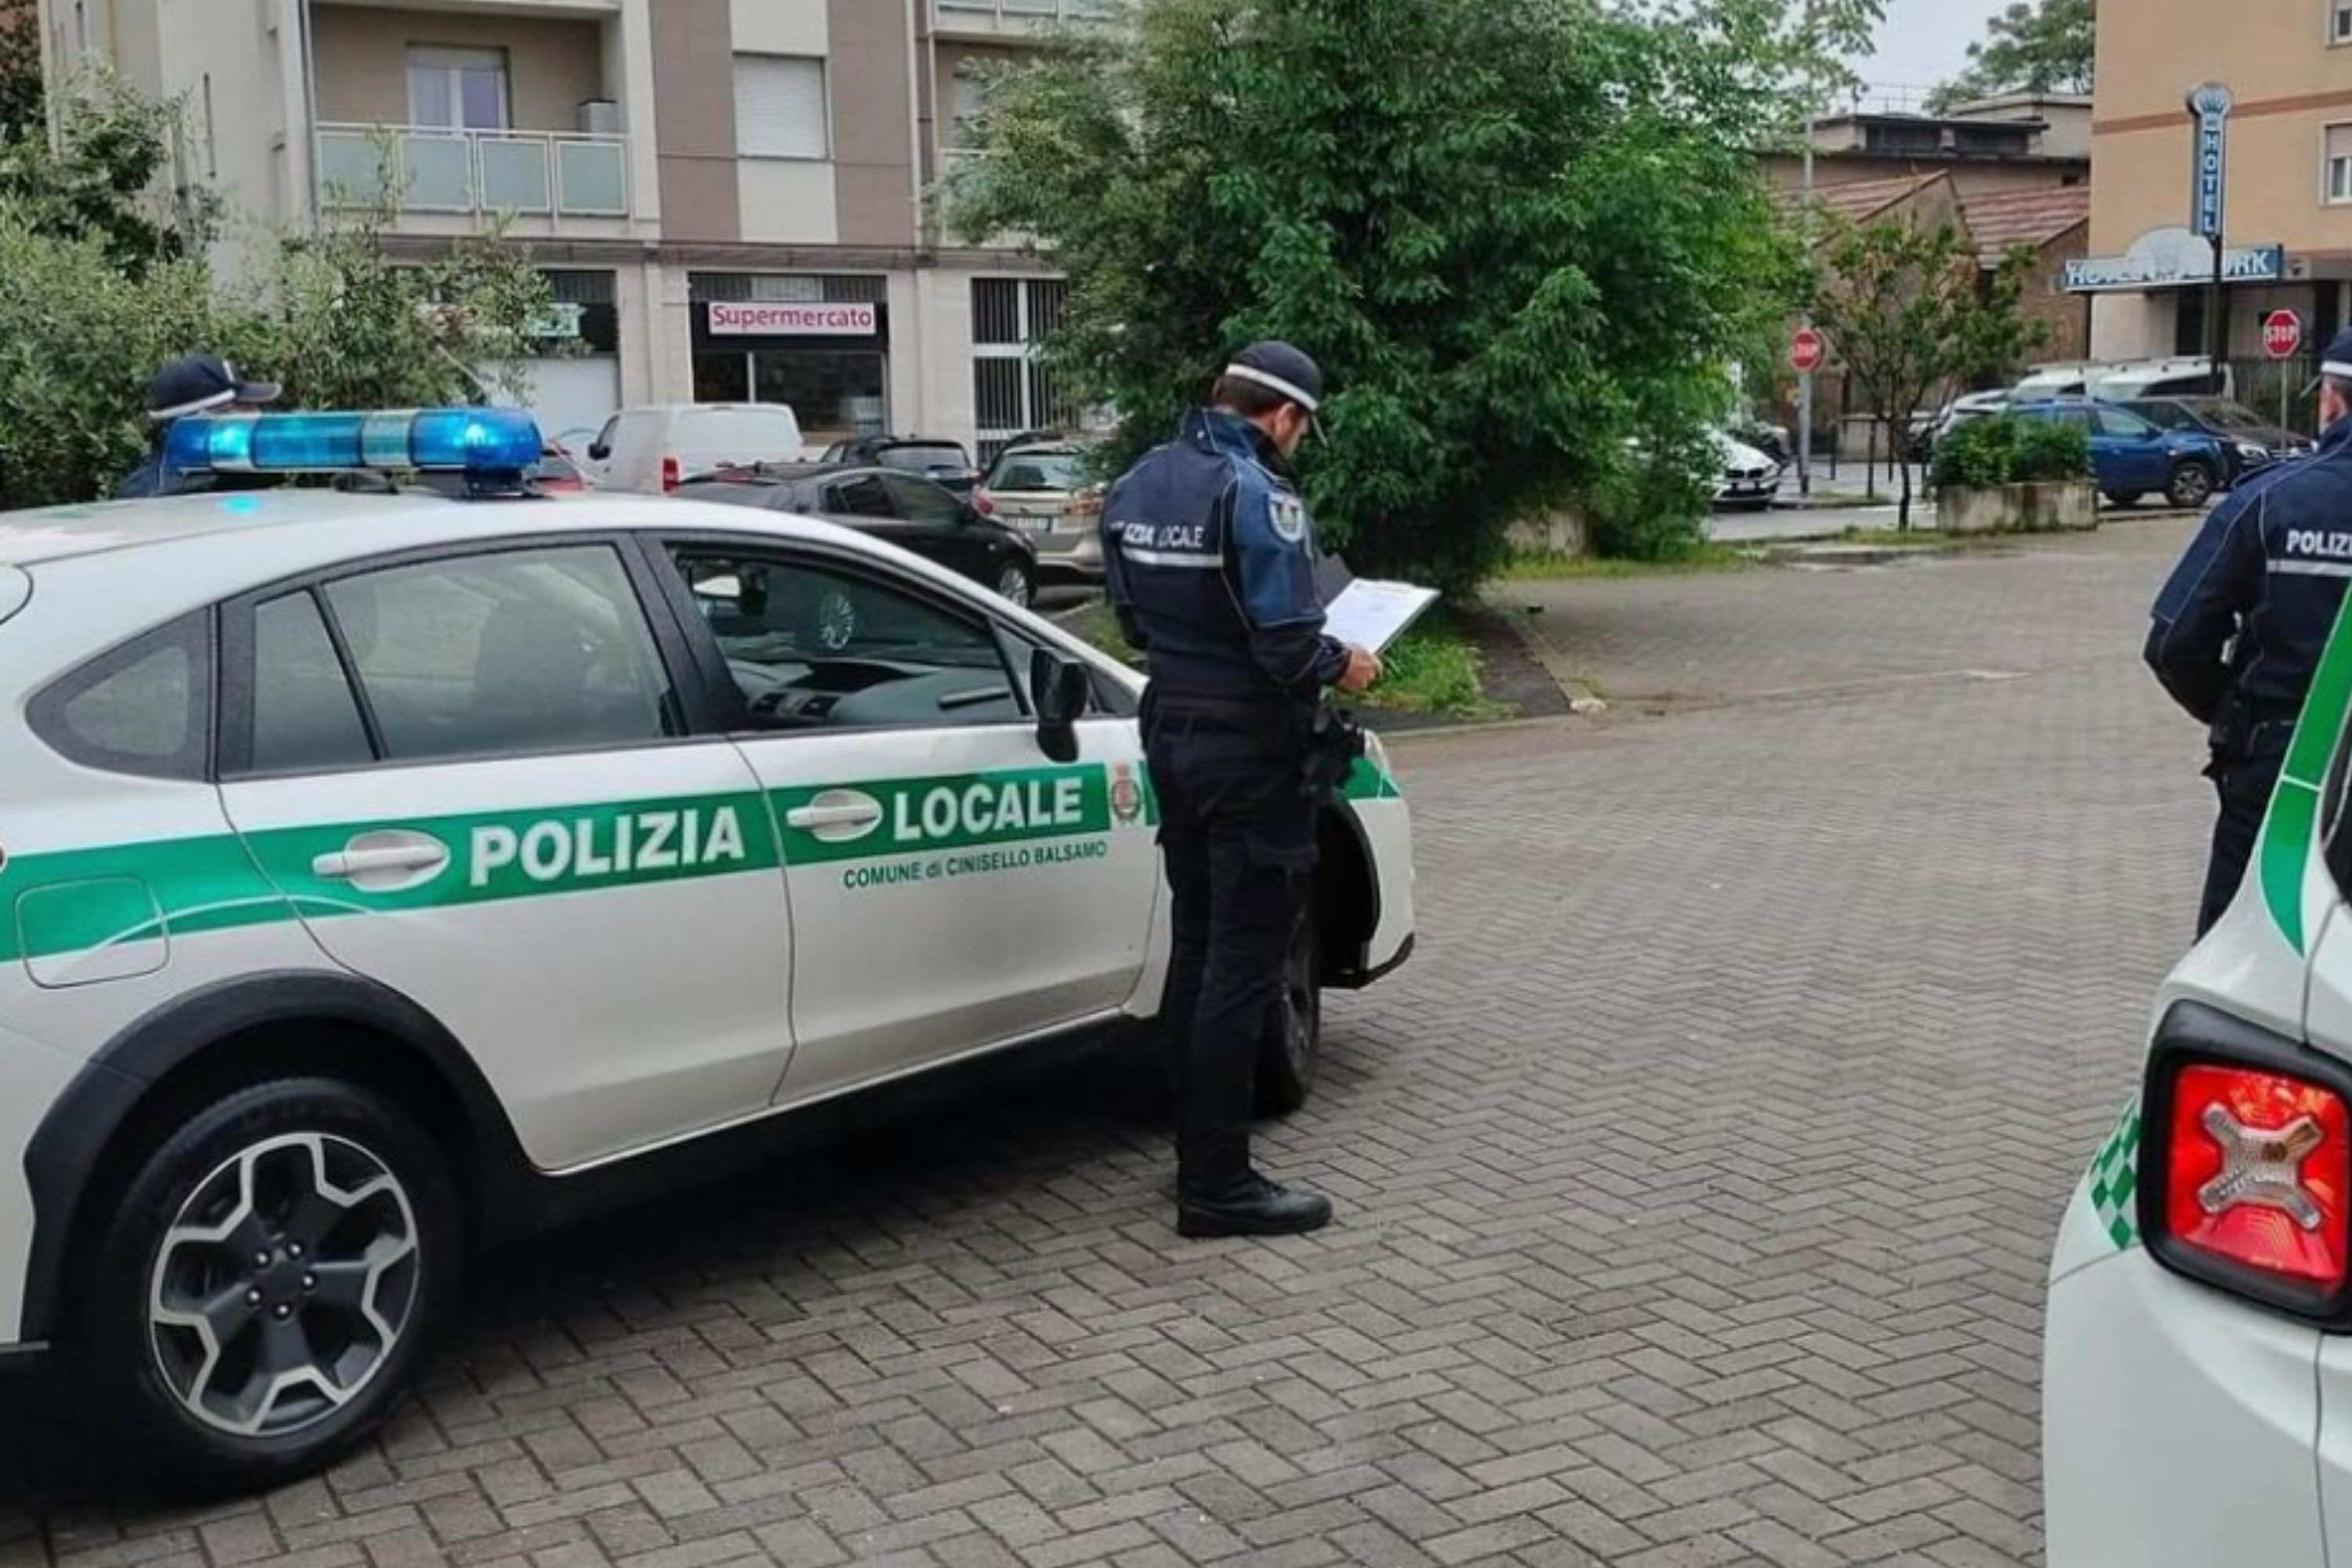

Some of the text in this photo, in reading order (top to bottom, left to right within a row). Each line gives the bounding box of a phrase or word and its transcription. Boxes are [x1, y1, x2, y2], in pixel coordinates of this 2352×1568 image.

[2203, 132, 2218, 233] HOTEL
[713, 305, 872, 329] Supermercato
[2264, 324, 2296, 343] STOP
[470, 777, 1083, 887] POLIZIA LOCALE
[844, 862, 922, 888] COMUNE
[946, 849, 1029, 877] CINISELLO
[1035, 840, 1107, 865] BALSAMO
